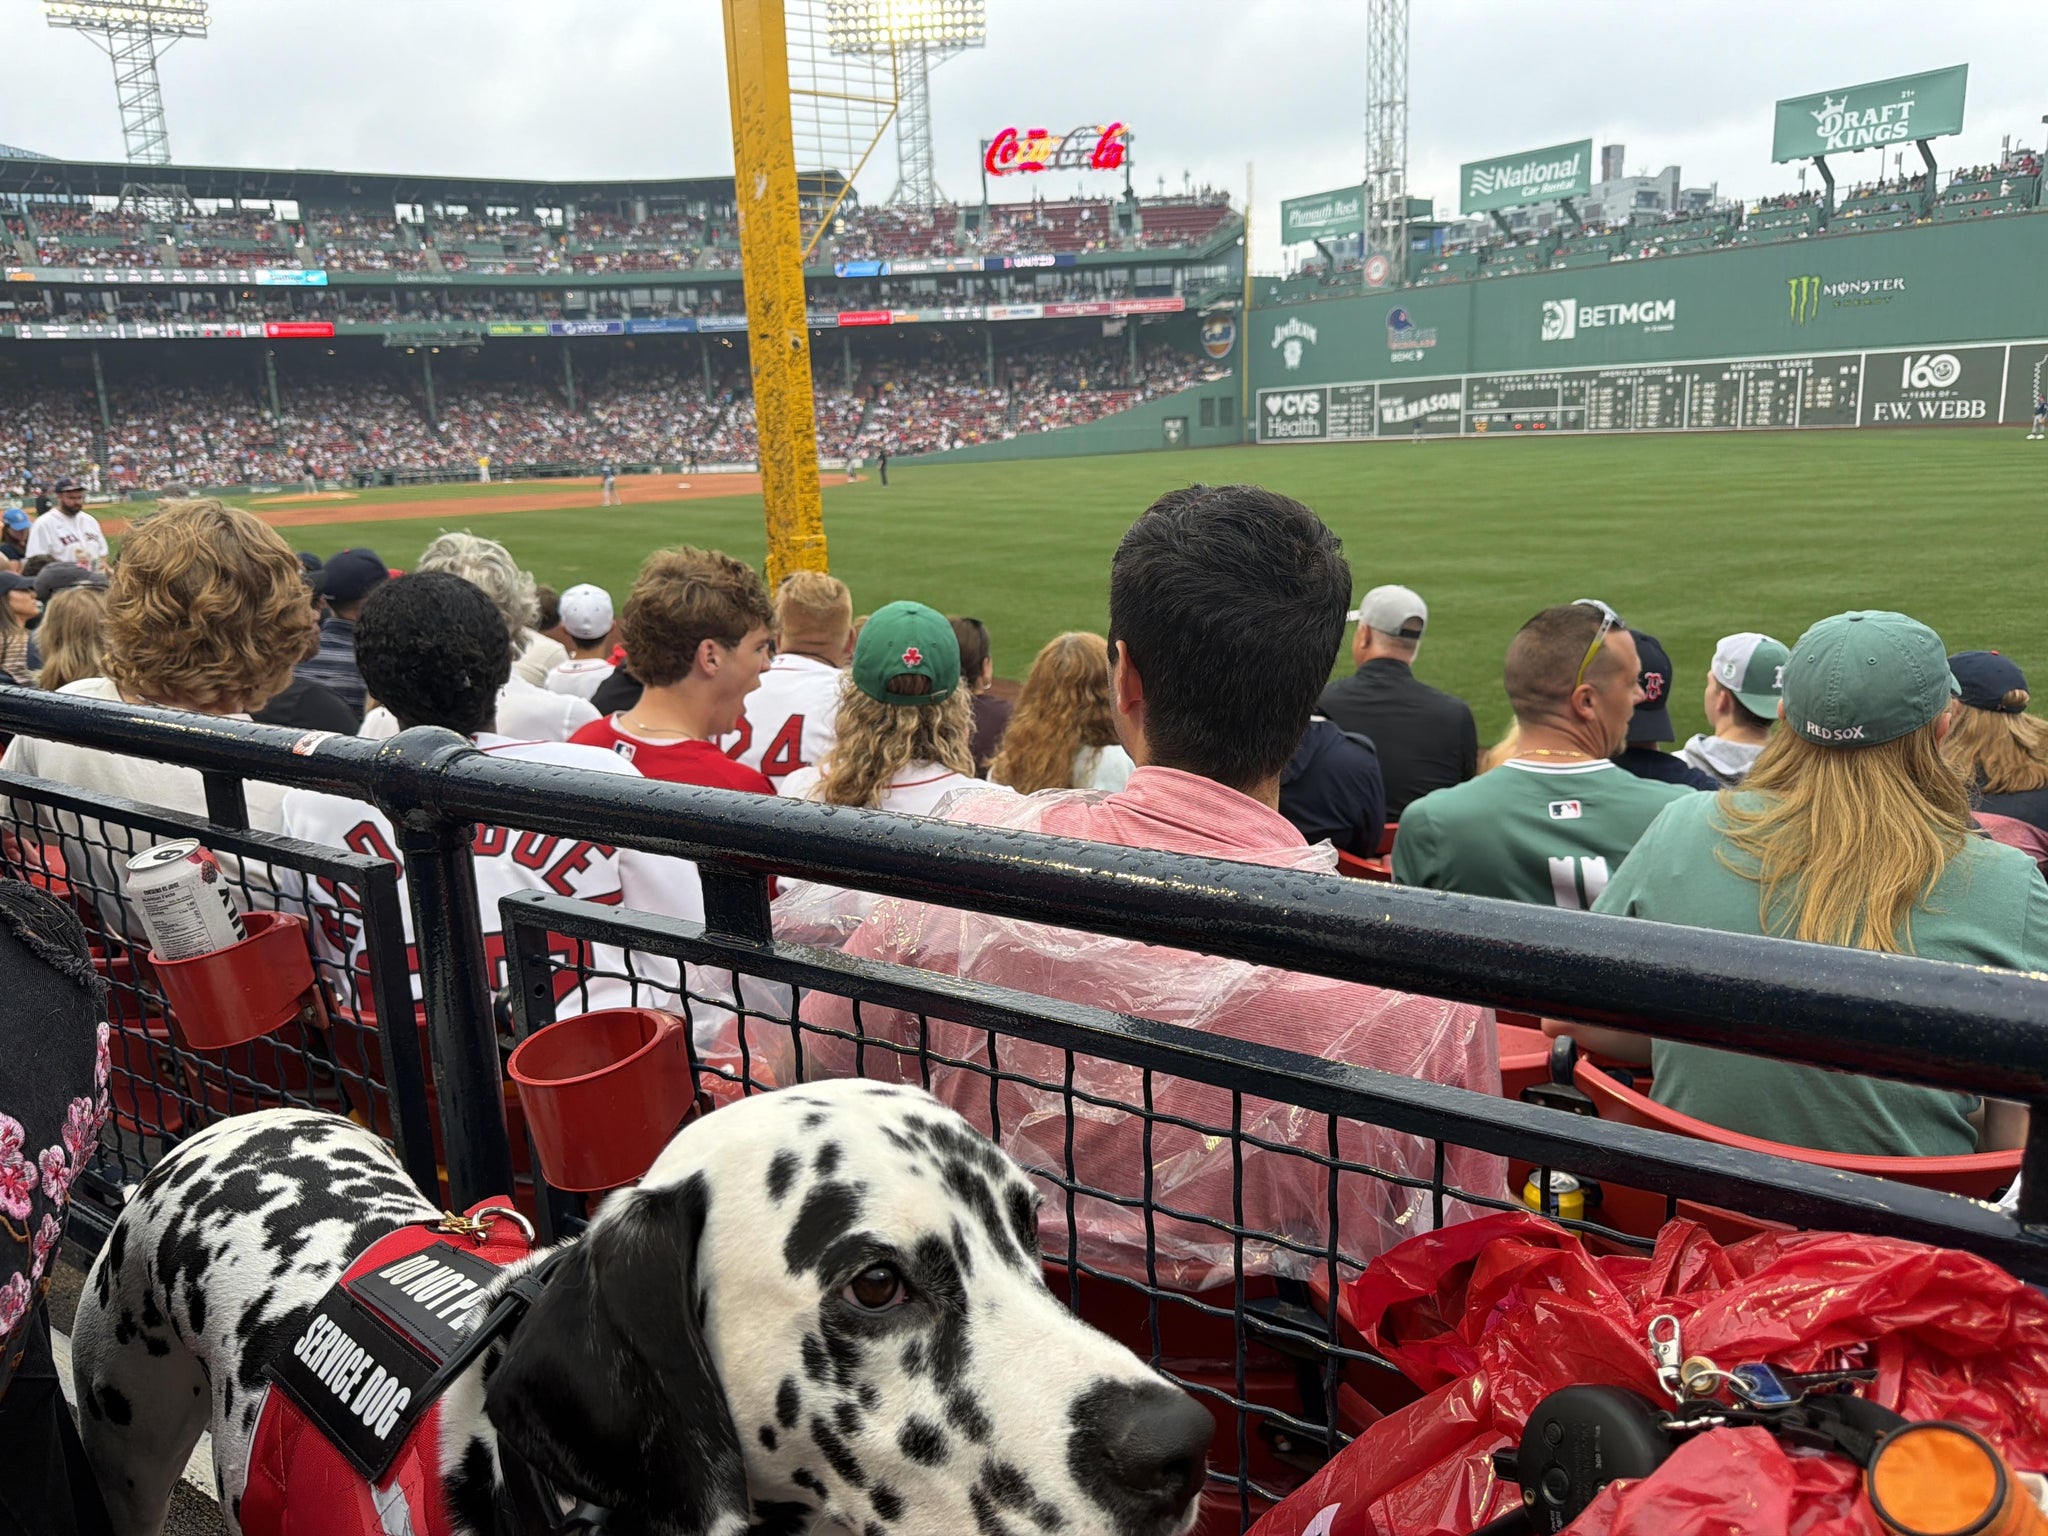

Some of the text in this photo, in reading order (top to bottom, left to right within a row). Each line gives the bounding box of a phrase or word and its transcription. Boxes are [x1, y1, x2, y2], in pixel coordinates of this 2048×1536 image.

[1901, 90, 1915, 99] 21+
[1817, 101, 1915, 137] DRAFT
[1826, 120, 1909, 150] KINGS
[1494, 152, 1580, 191] National
[1521, 184, 1540, 198] Car
[1289, 203, 1333, 225] Plymouth
[1822, 277, 1906, 297] MONSTER
[1578, 299, 1676, 328] BETMGM
[1730, 359, 1814, 371] NATIONAL LEAGUE
[1901, 354, 1961, 389] 160
[1283, 392, 1321, 416] CVS
[1909, 391, 1936, 399] YEARS
[1873, 399, 1986, 421] F.W. WEBB
[1267, 416, 1321, 437] Health
[1806, 720, 1865, 741] RED SOX
[378, 1254, 440, 1286] DO
[400, 1265, 479, 1311] NOT
[293, 1313, 412, 1441] SERVICE DOG
